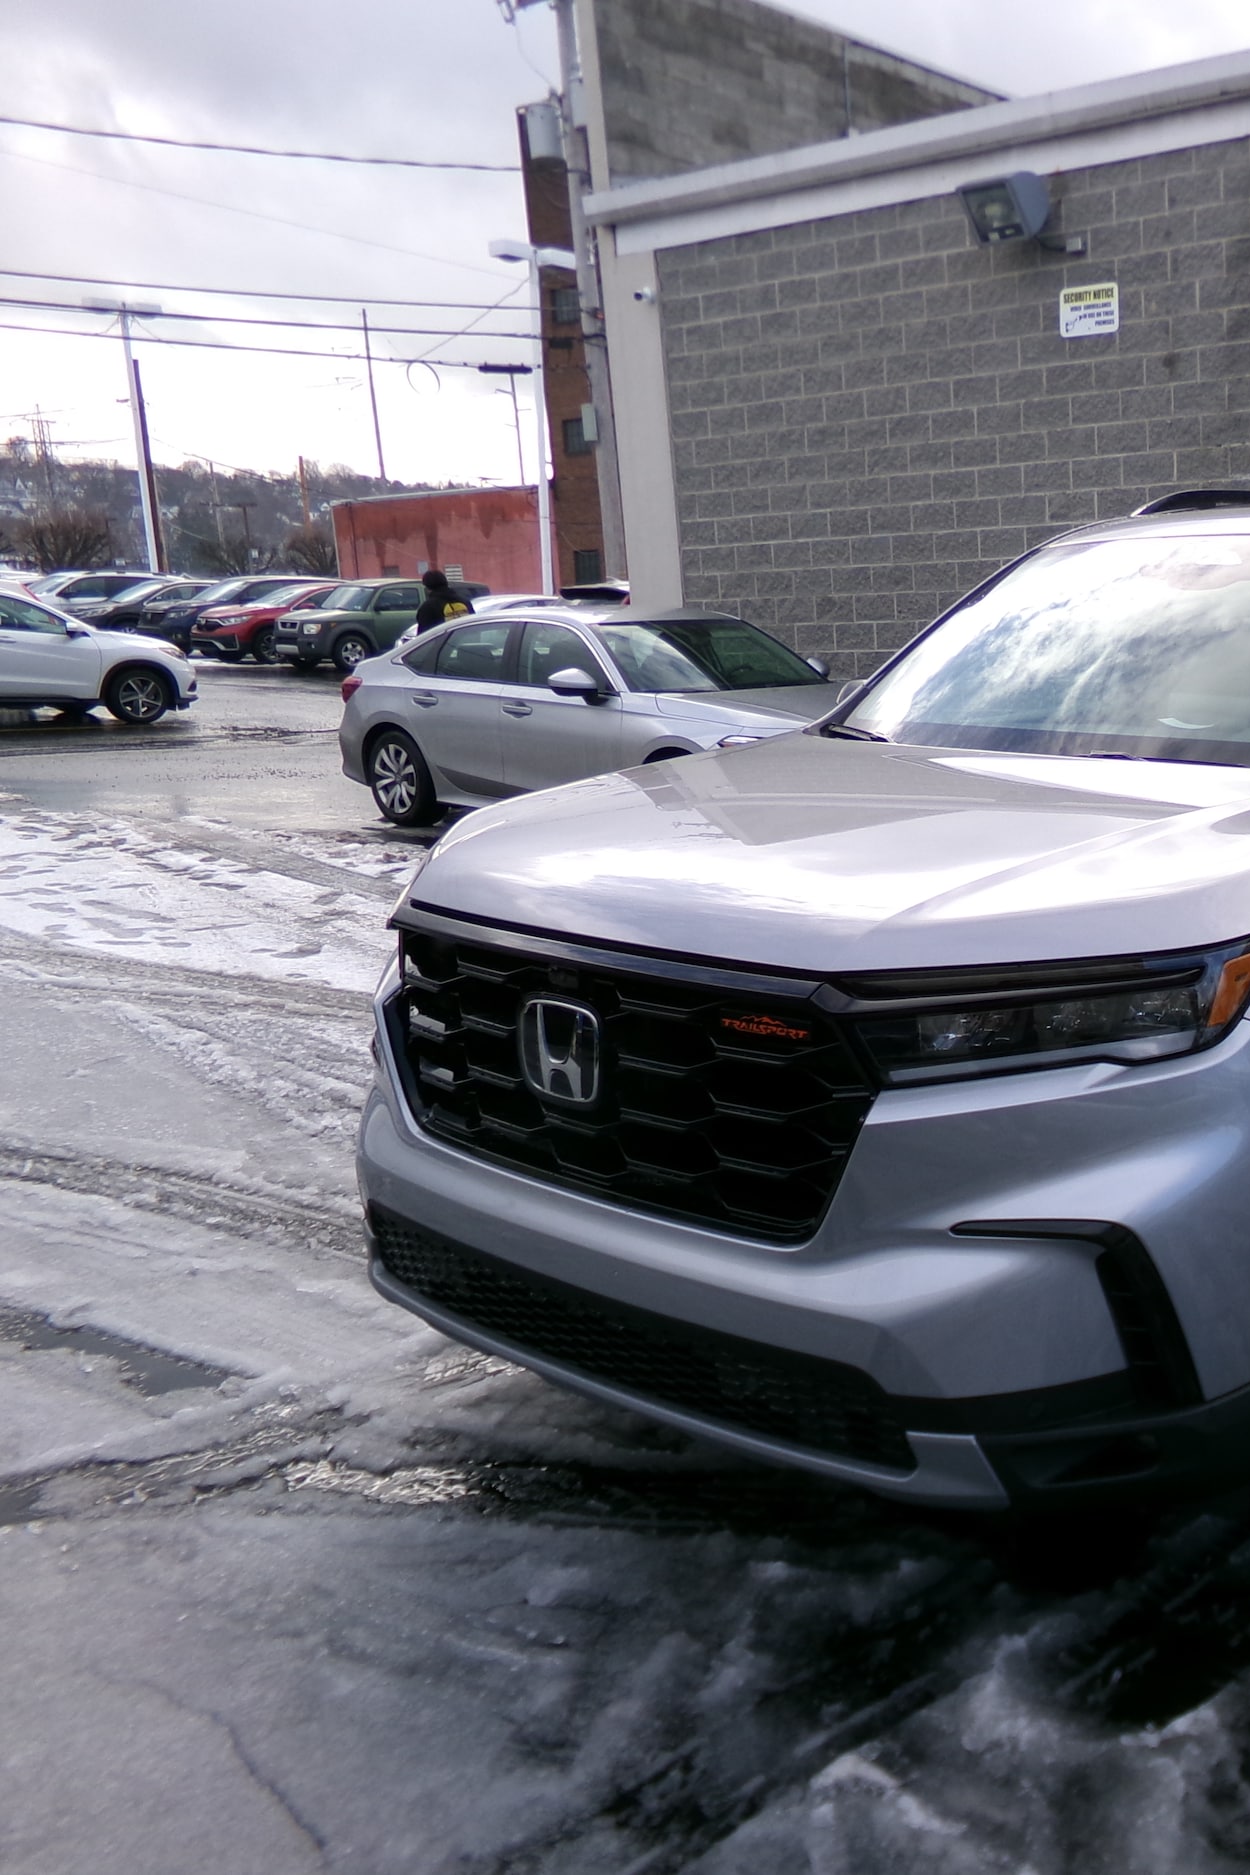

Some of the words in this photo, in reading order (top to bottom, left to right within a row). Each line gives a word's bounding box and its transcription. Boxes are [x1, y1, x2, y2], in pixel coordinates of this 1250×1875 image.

[1063, 290, 1092, 304] SECURITY
[1093, 287, 1114, 300] NOTICE
[721, 1018, 809, 1040] TRAILSPORT
